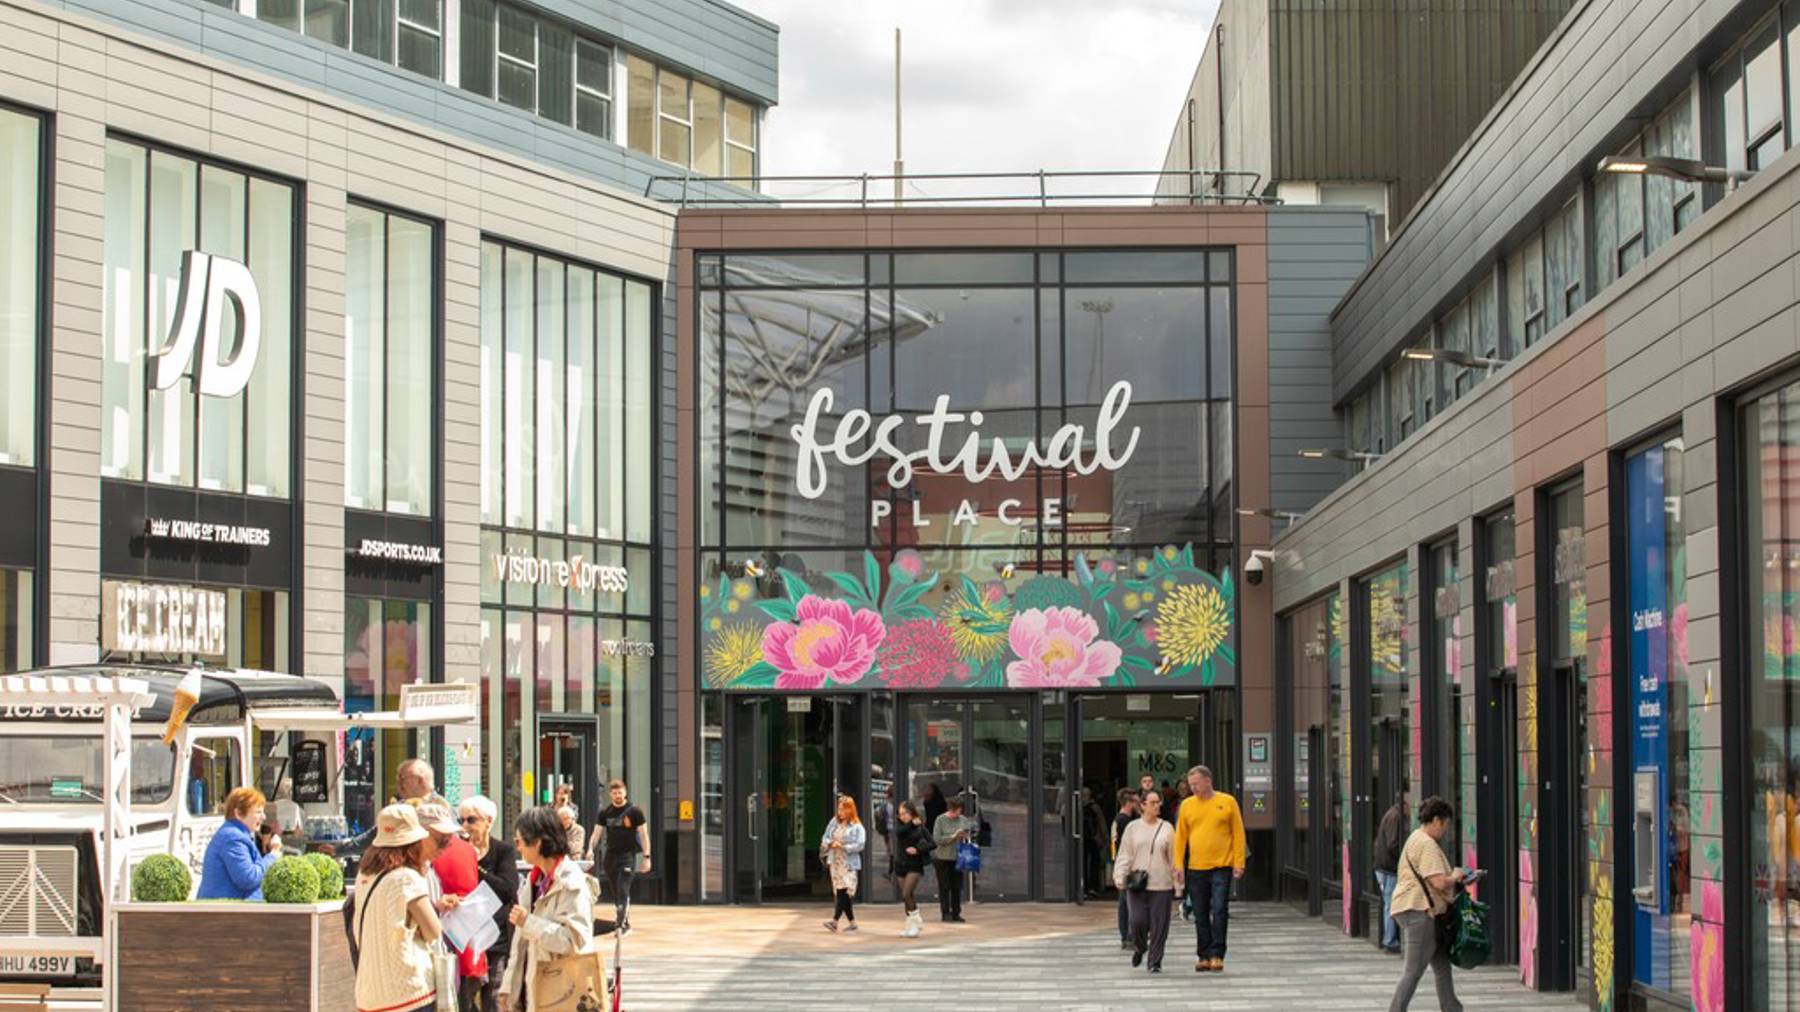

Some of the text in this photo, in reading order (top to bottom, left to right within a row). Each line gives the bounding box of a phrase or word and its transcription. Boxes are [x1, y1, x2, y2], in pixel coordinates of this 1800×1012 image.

[147, 249, 261, 398] JD
[791, 380, 1141, 499] festival
[871, 498, 1063, 527] PLACE
[170, 520, 270, 546] KING OF TRAINERS
[359, 539, 441, 563] JDSPORTS.CO.UK
[494, 547, 551, 585] vision
[117, 582, 226, 656] ICE CREAM
[4, 702, 46, 718] ICE
[1138, 752, 1177, 773] M&S
[28, 957, 69, 972] 499V
